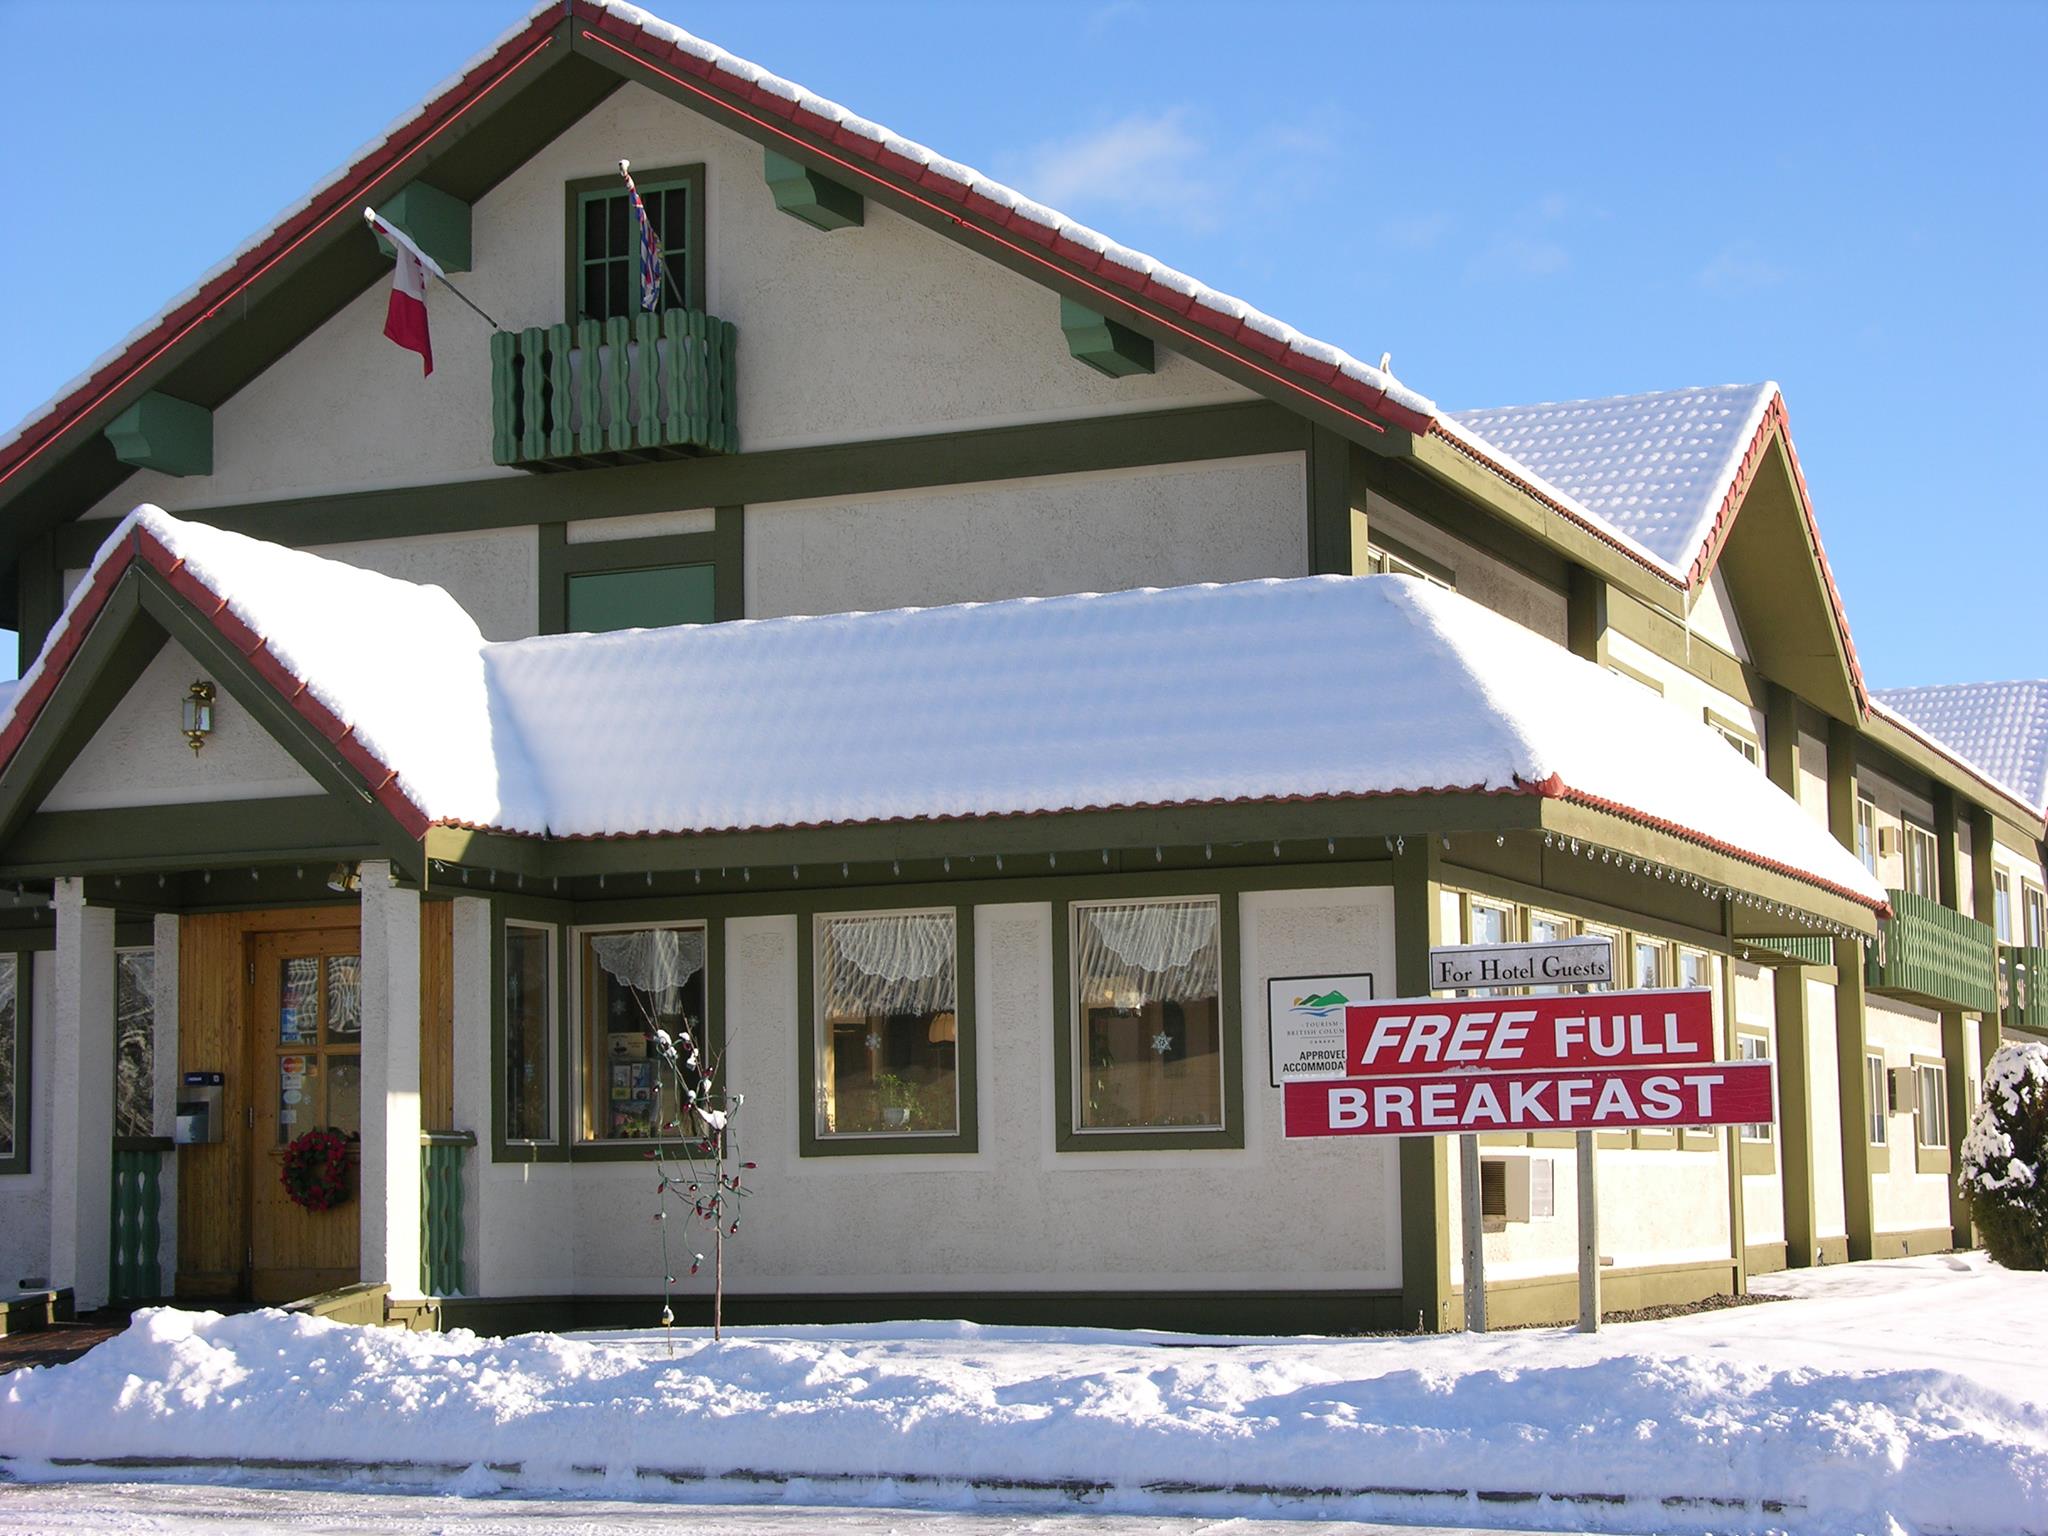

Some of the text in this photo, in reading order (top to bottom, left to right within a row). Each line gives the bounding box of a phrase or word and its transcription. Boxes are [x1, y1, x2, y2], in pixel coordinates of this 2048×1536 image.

[1439, 955, 1605, 983] For Hotel Guests
[1361, 1010, 1699, 1065] FREE FULL
[1282, 1060, 1346, 1072] ACCOMMODA
[1327, 1074, 1725, 1130] BREAKFAST
